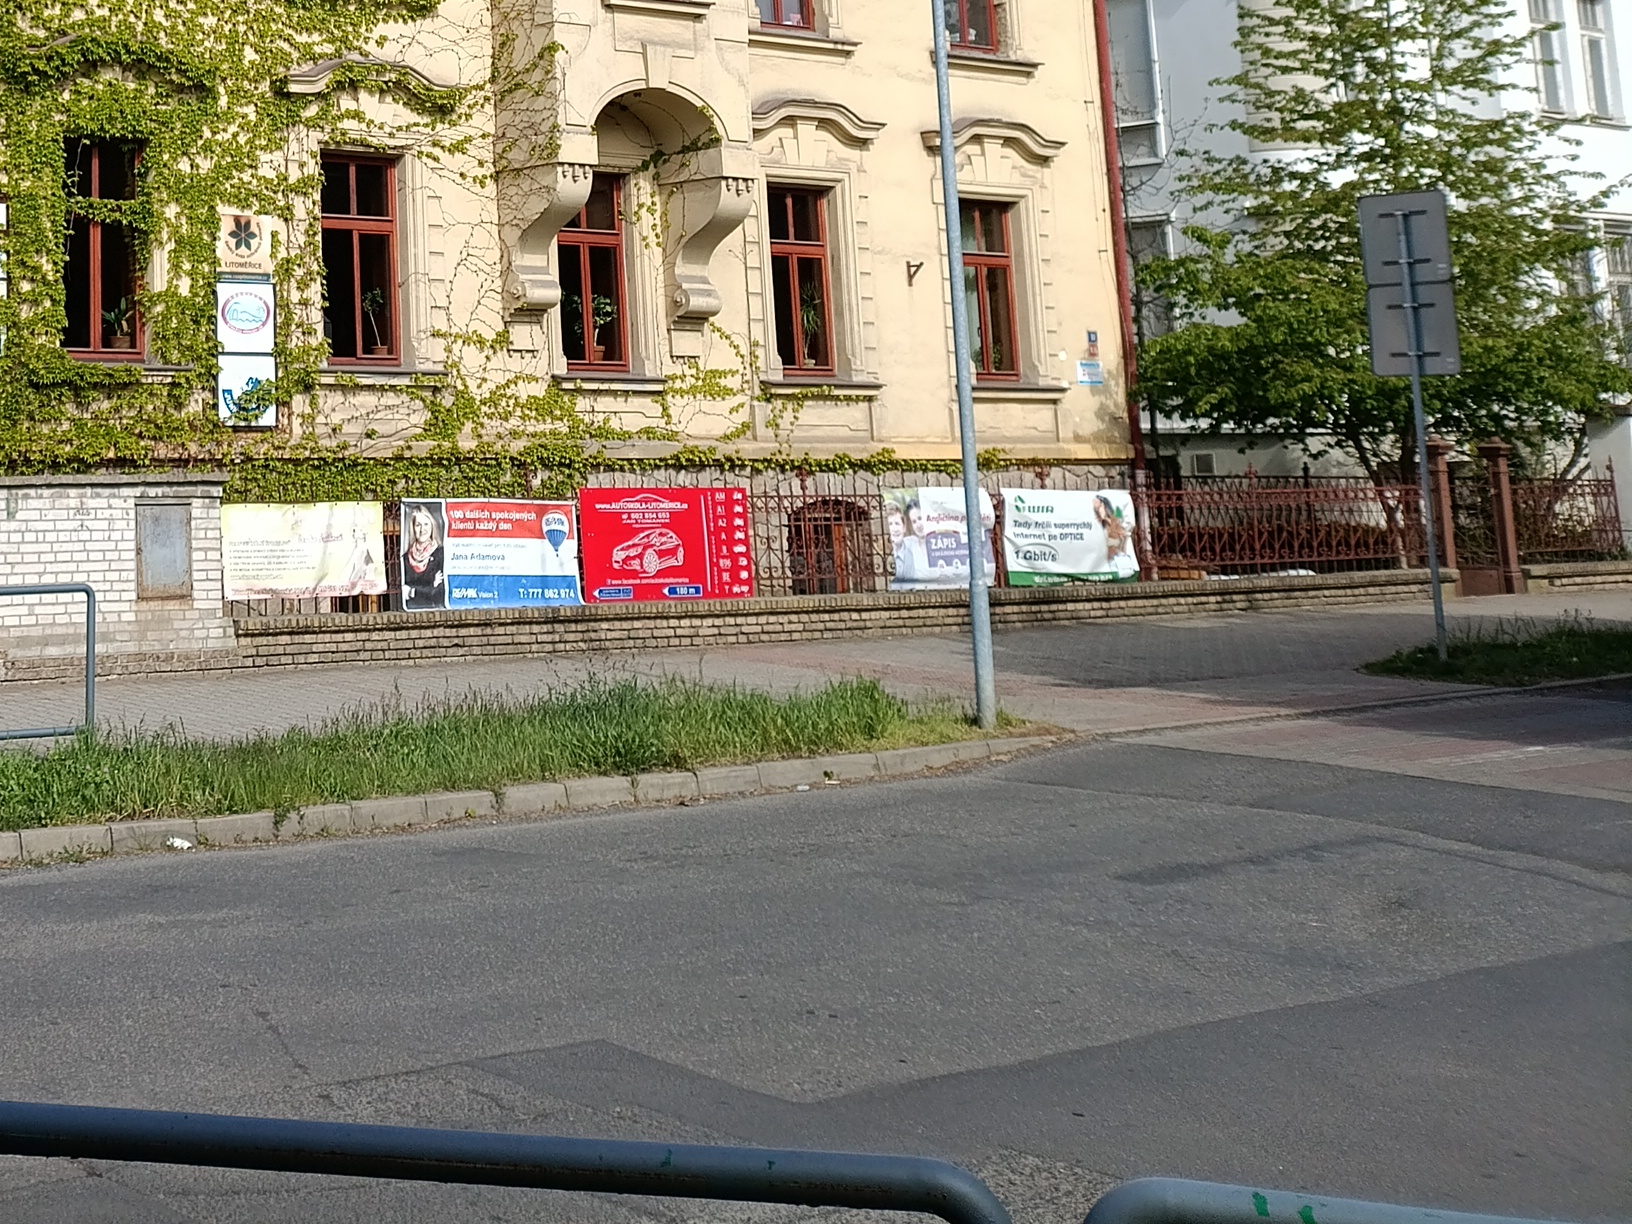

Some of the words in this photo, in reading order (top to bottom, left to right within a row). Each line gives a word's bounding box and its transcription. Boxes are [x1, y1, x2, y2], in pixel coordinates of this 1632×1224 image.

[450, 510, 464, 519] 100
[465, 509, 490, 520] dalších
[491, 510, 537, 521] spokojených
[476, 520, 497, 532] každý
[499, 522, 513, 530] den
[718, 518, 727, 527] A2
[1013, 520, 1032, 530] Tady
[1048, 533, 1058, 542] po
[1059, 533, 1085, 541] OPTICE
[930, 536, 957, 550] ZÁPIS
[451, 552, 468, 561] Jana
[1014, 549, 1020, 560] 1
[1023, 550, 1058, 562] Gbit/s
[518, 588, 528, 598] T:
[528, 588, 542, 599] 777
[560, 588, 575, 599] 974
[676, 586, 687, 595] 180
[688, 587, 696, 595] m
